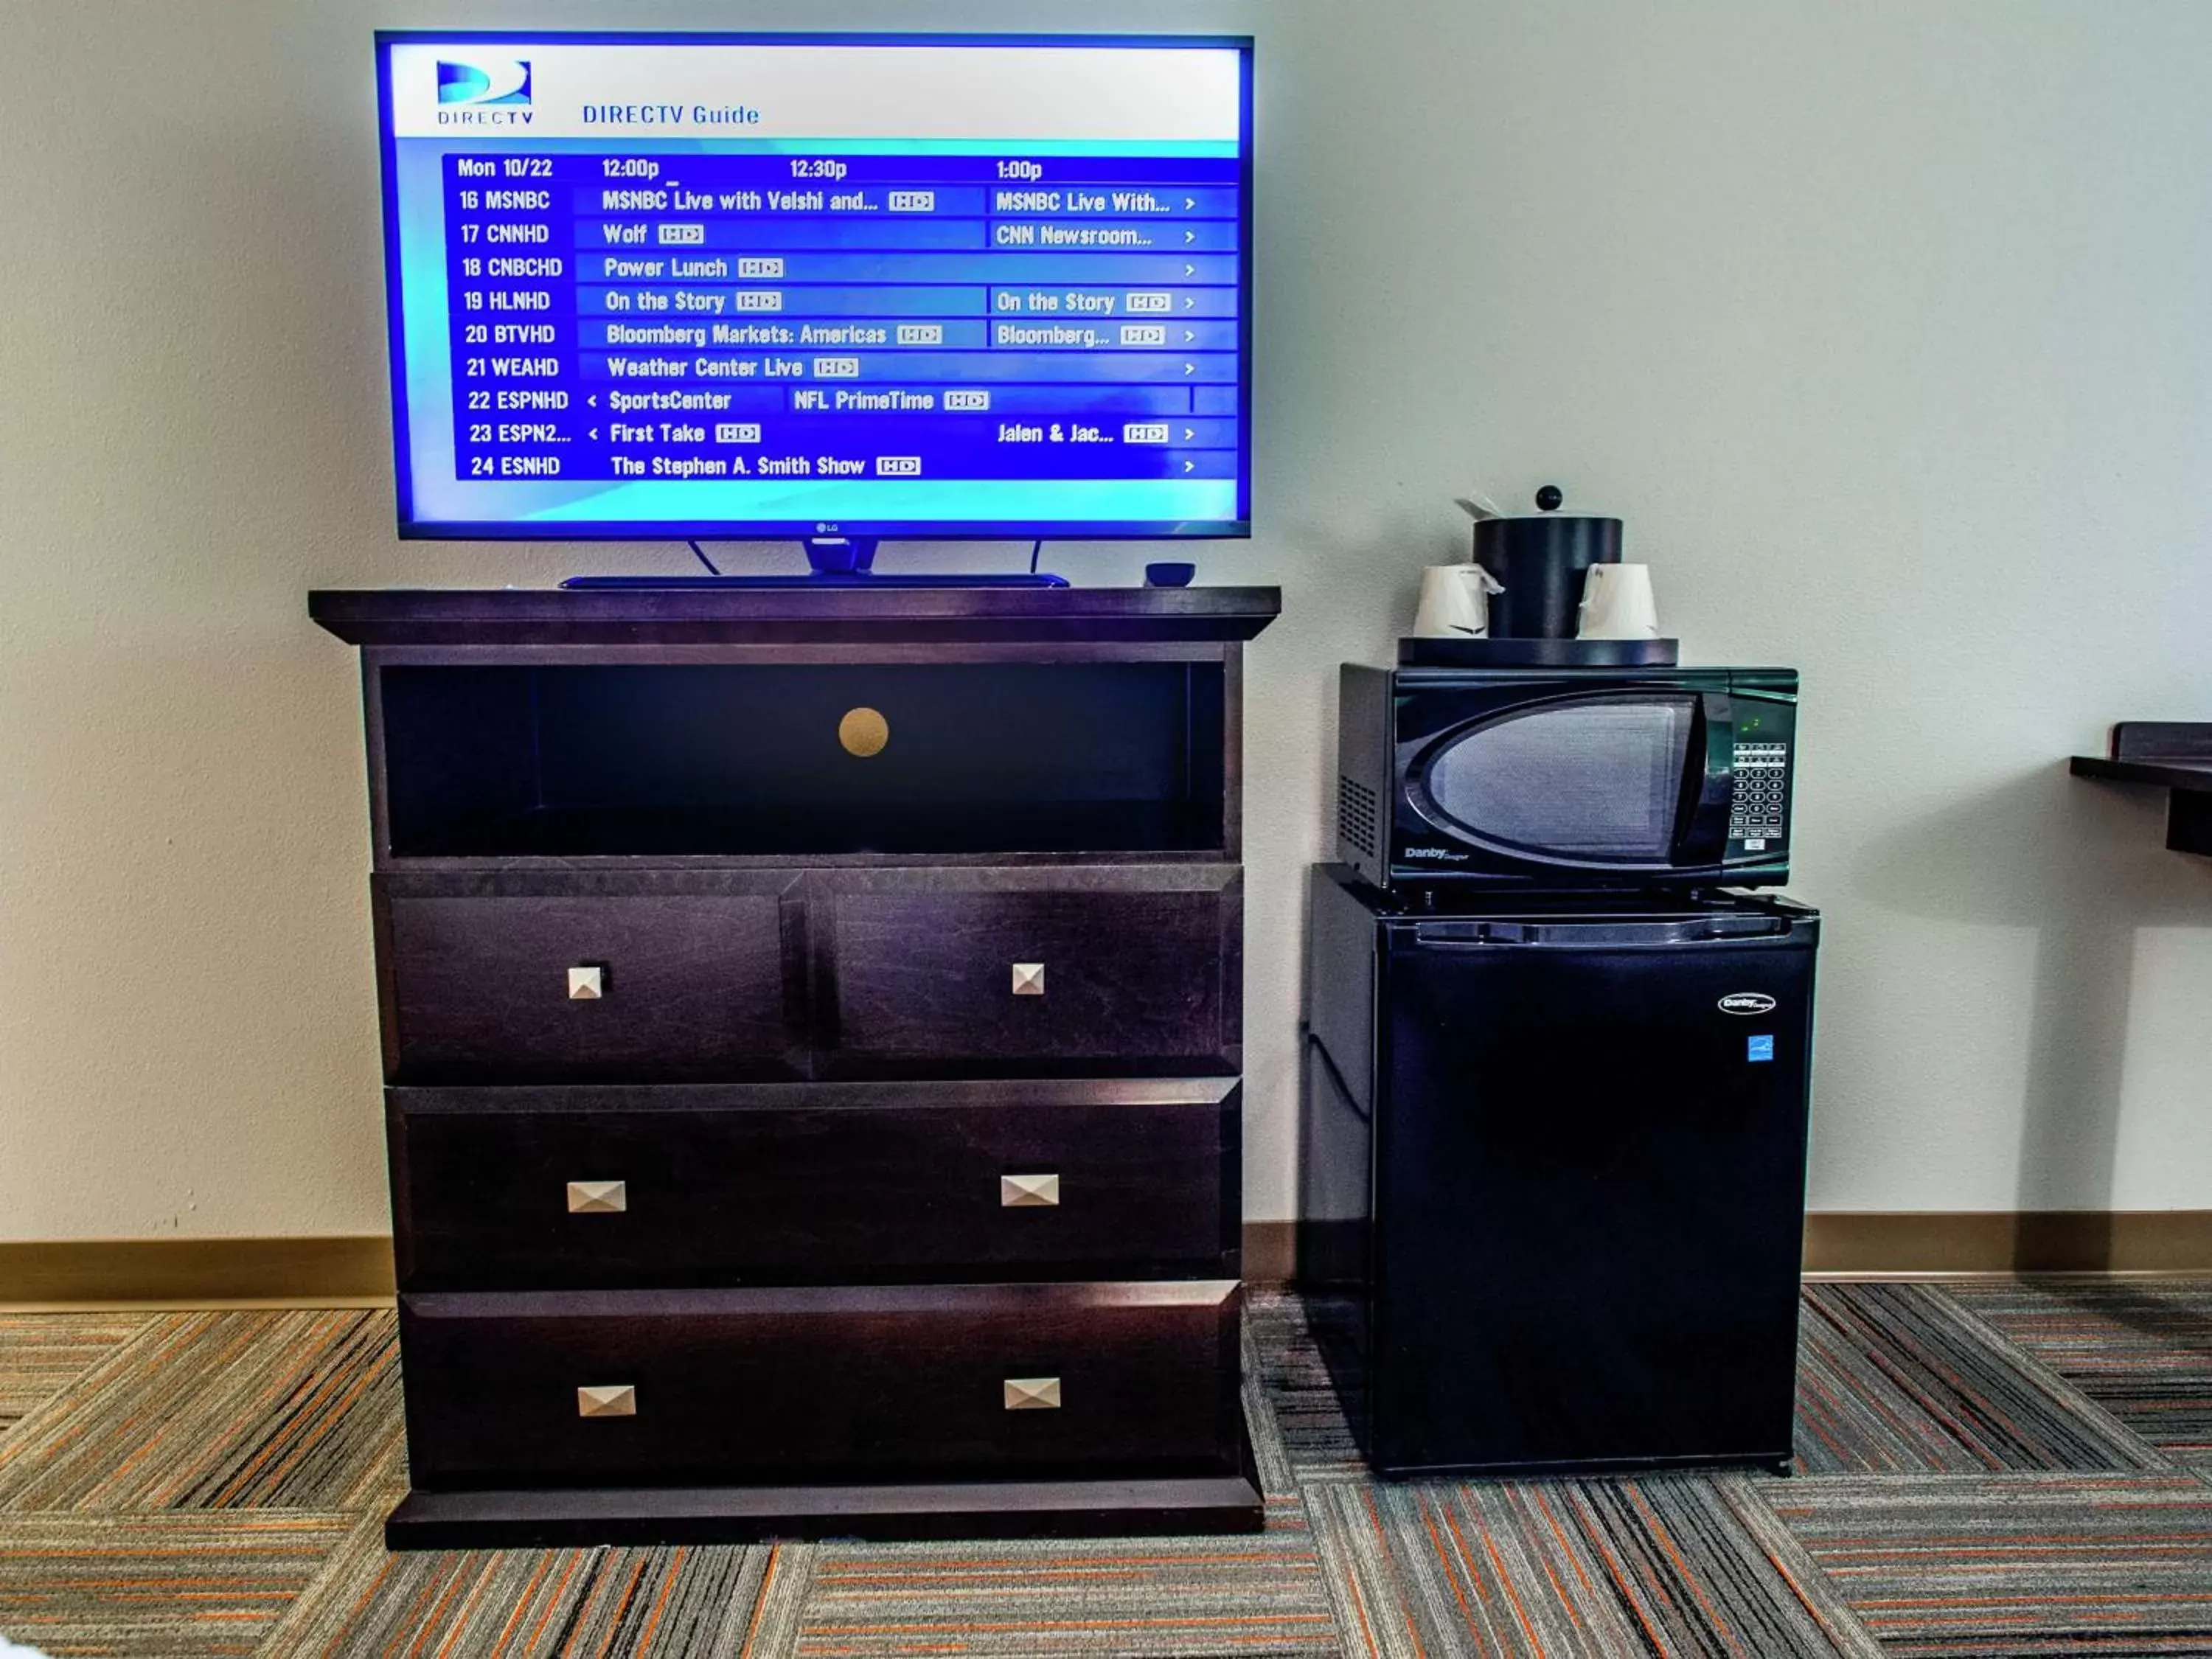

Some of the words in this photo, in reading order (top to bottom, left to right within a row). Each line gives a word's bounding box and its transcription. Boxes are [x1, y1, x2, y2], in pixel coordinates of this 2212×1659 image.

[438, 111, 533, 125] DIRECTV
[583, 105, 684, 124] DIRECTV
[693, 105, 759, 124] Guide
[458, 159, 495, 177] Mon
[504, 159, 553, 177] 10/22
[602, 159, 660, 180] 12:00p
[790, 160, 847, 181] 12:30p
[996, 161, 1042, 181] 1:00p
[460, 191, 479, 209] 16
[485, 191, 550, 209] MSNBC
[602, 191, 667, 209] MSNBC
[674, 191, 713, 209] Live
[720, 191, 762, 210] with
[768, 191, 824, 210] Velshi
[830, 192, 878, 210] and...
[996, 192, 1061, 211] MSNBC
[1067, 192, 1106, 211] Live
[1112, 192, 1171, 212] With...
[461, 225, 479, 243] 17
[487, 225, 549, 243] CNNHD
[602, 224, 647, 243] Wolf
[996, 226, 1034, 244] CNN
[1040, 226, 1152, 245] Newsroom...
[462, 258, 481, 276] 18
[488, 258, 563, 276] CNBCHD
[605, 257, 664, 276] Power
[671, 257, 728, 276] Lunch
[464, 291, 482, 310] 19
[490, 291, 550, 310] HLNHD
[606, 291, 630, 310] On
[637, 291, 669, 310] the
[675, 291, 726, 314] Story
[997, 292, 1021, 311] On
[1029, 292, 1058, 310] the
[1065, 293, 1116, 314] Story
[465, 324, 487, 343] 20
[495, 324, 555, 343] BTVHD
[607, 324, 706, 347] Bloomberg
[712, 324, 794, 344] Markets:
[800, 325, 886, 344] Americas
[998, 325, 1109, 348] Bloomberg...
[467, 358, 485, 376] 21
[491, 358, 560, 376] WEAHD
[608, 358, 688, 377] Weather
[695, 358, 758, 377] Center
[764, 358, 804, 377] Live
[468, 391, 490, 409] 22
[497, 391, 568, 409] ESPNHD
[609, 391, 731, 413] SportsCenter
[794, 391, 830, 410] NFL
[835, 391, 934, 410] PrimeTime
[470, 424, 492, 442] 23
[498, 424, 571, 442] ESPN2...
[611, 424, 654, 442] First
[660, 424, 706, 442] Take
[998, 424, 1043, 442] Jalen
[1048, 424, 1065, 443] &
[1069, 424, 1114, 442] Jac...
[471, 457, 493, 475] 24
[501, 457, 560, 475] ESNHD
[611, 457, 646, 475] The
[652, 457, 726, 479] Stephen
[733, 457, 751, 475] A.
[757, 457, 810, 475] Smith
[817, 457, 866, 475] Show
[1404, 847, 1447, 860] Danby
